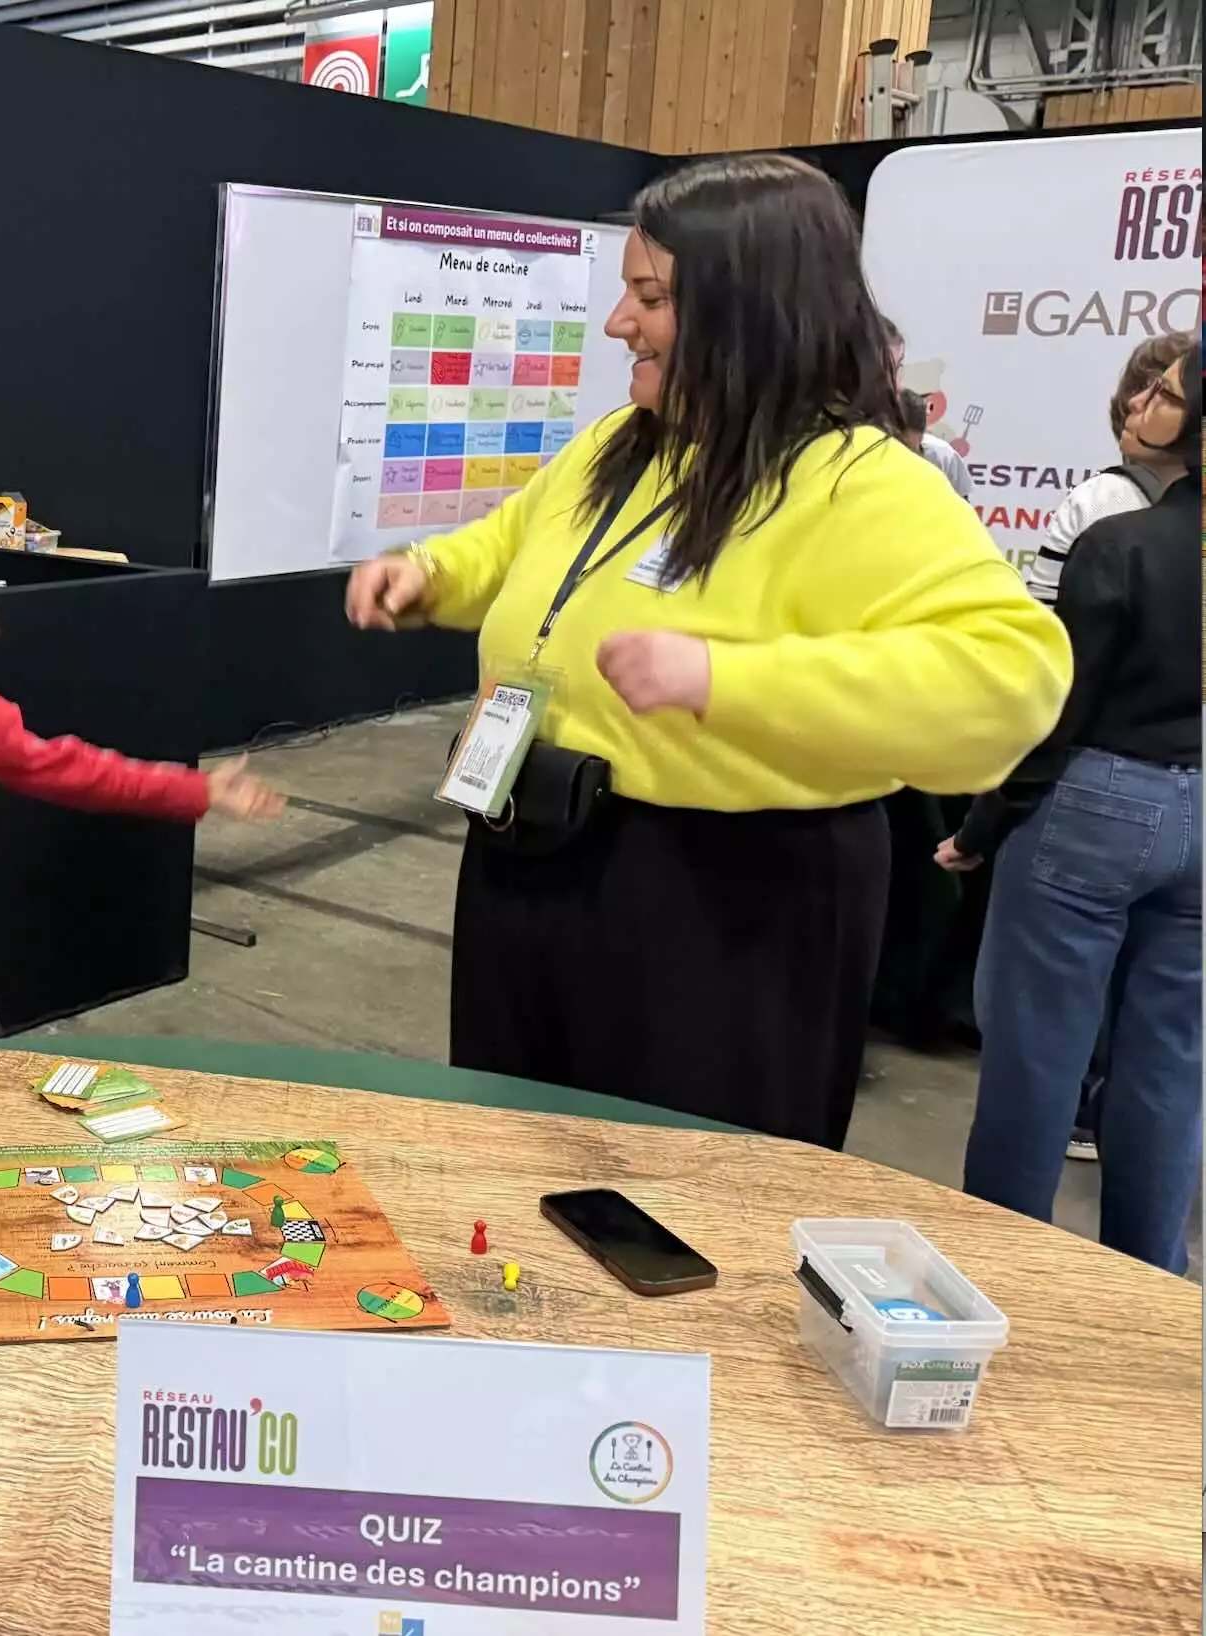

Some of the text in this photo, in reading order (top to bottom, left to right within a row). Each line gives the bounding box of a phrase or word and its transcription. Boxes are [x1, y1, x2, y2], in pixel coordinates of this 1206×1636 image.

[387, 216, 397, 231] Et
[398, 218, 408, 232] si
[409, 221, 421, 233] on
[423, 221, 473, 238] composait
[474, 228, 486, 240] un
[487, 230, 513, 242] menu
[513, 230, 525, 243] de
[526, 232, 572, 248] collectivité
[439, 252, 529, 276] Menu de cantine
[445, 294, 469, 307] Mardi
[988, 295, 1020, 315] LE
[143, 1389, 214, 1404] RÉSEAU
[359, 1513, 443, 1547] QUIZ
[170, 1545, 641, 1602] “La cantine des champions”
